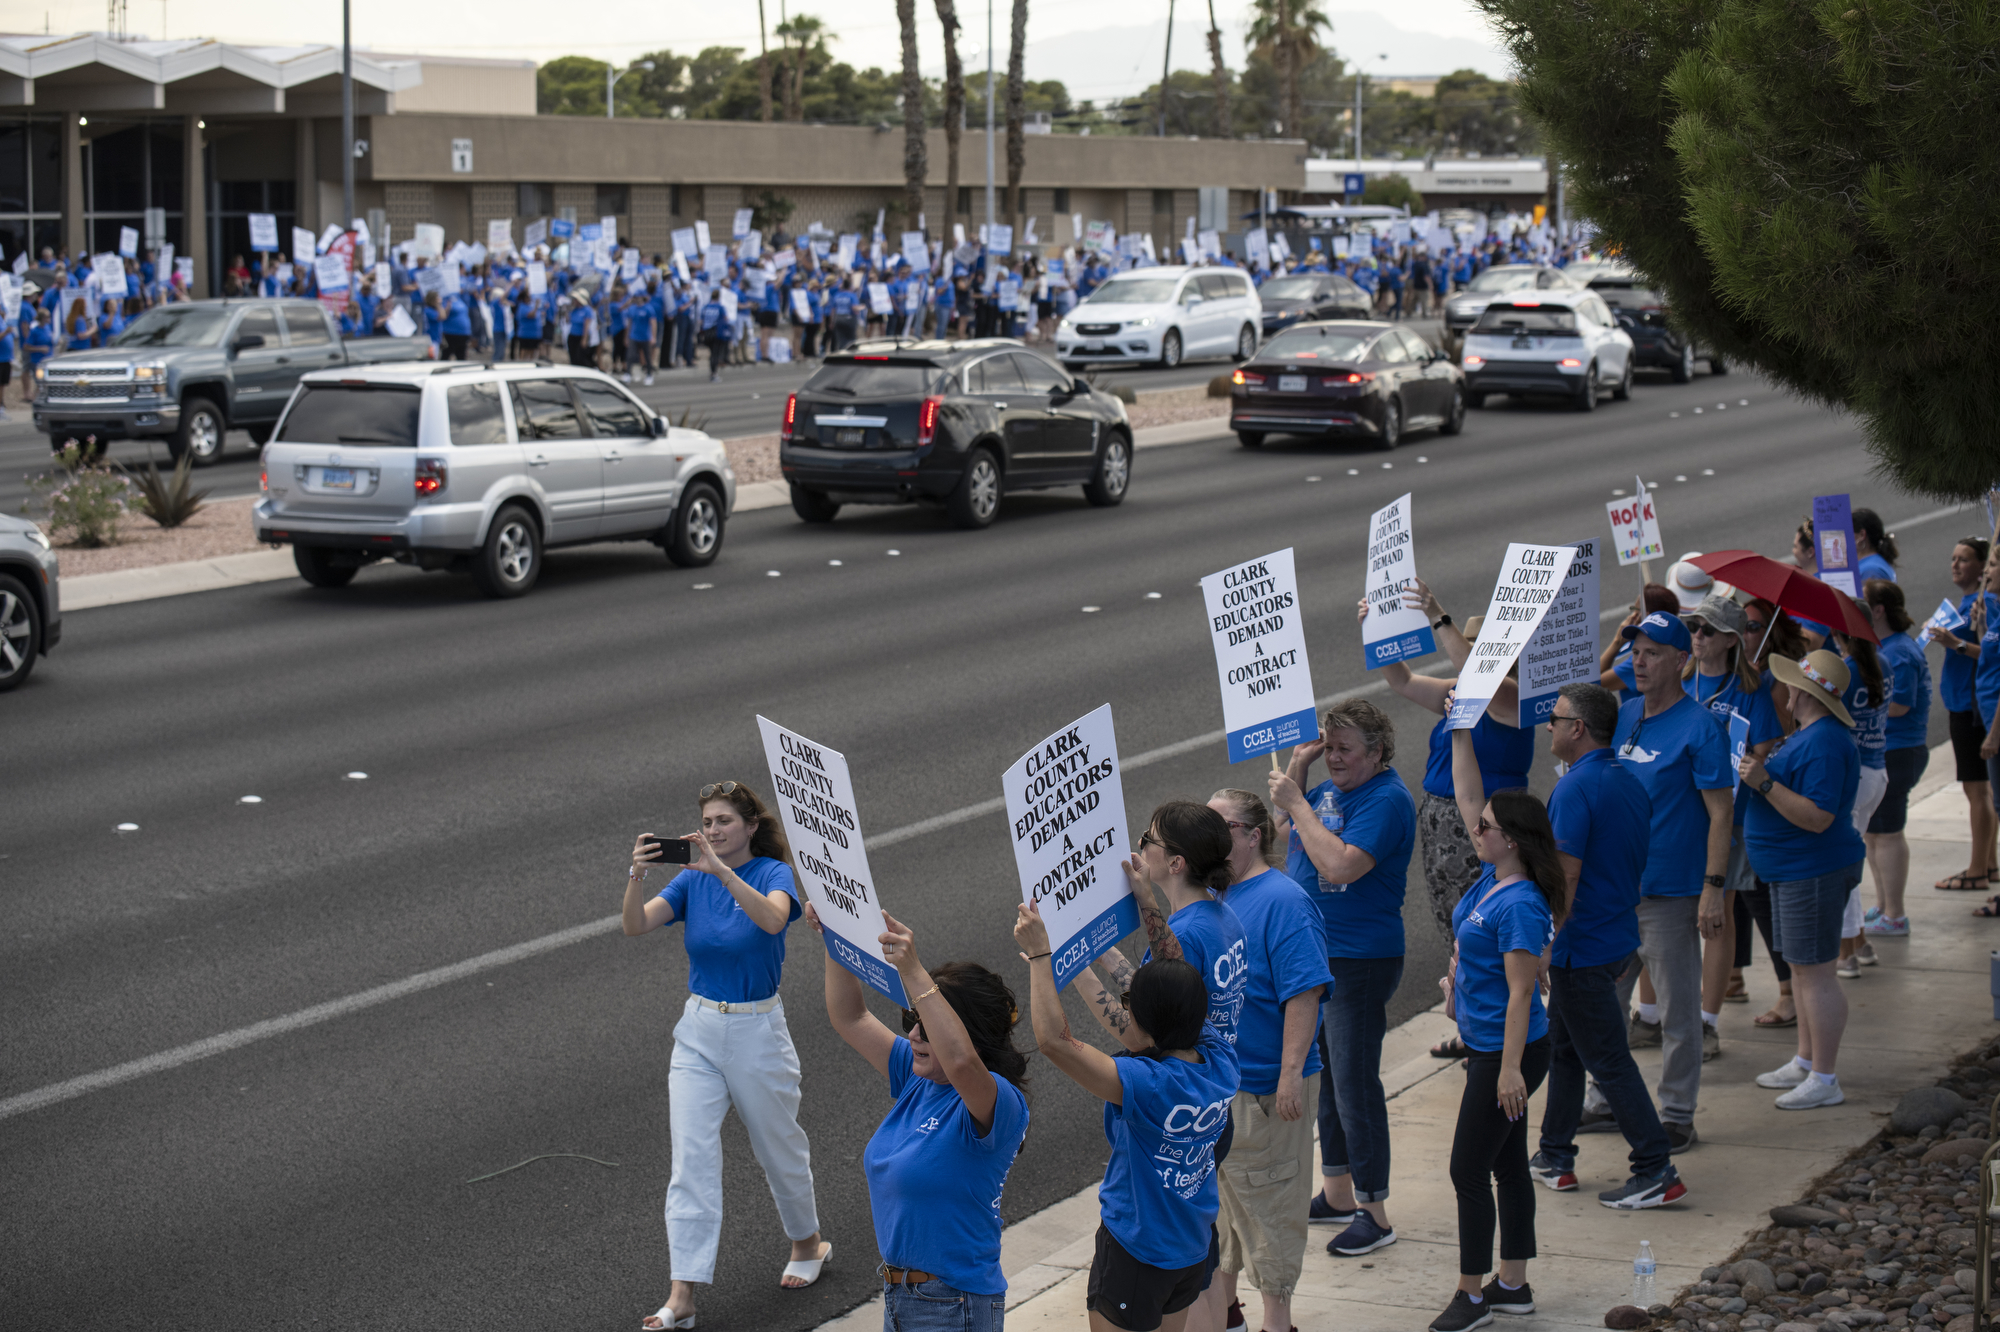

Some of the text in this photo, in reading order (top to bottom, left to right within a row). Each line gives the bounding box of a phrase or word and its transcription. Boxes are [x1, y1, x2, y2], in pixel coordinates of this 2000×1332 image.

[1379, 502, 1400, 525] CLARK
[1375, 517, 1402, 542] COUNTY
[1369, 529, 1409, 561] EDUCATORS
[1573, 543, 1594, 559] OR
[1372, 548, 1404, 573] DEMAND
[1521, 549, 1558, 567] CLARK
[1223, 560, 1270, 589] CLARK
[1384, 569, 1390, 583] A
[1511, 568, 1554, 586] COUNTY
[1222, 577, 1276, 609] COUNTY
[1367, 578, 1411, 605] CONTRACT
[1495, 586, 1554, 604] EDUCATORS
[1562, 586, 1579, 597] Year
[1581, 583, 1585, 593] 1
[1213, 591, 1294, 633] EDUCATORS
[1378, 597, 1402, 617] NOW!
[1496, 605, 1537, 622] DEMAND
[1551, 598, 1584, 615] in Year 2
[1227, 614, 1284, 647] DEMAND
[1501, 625, 1512, 639] A
[1542, 620, 1554, 632] 5%
[1555, 618, 1566, 629] for
[1566, 612, 1587, 626] SPED
[1540, 633, 1555, 648] $5K
[1556, 632, 1567, 643] for
[1567, 627, 1584, 640] Title
[1254, 641, 1265, 658] A
[1375, 641, 1402, 659] CCEA
[1475, 642, 1522, 657] CONTRACT
[1527, 640, 1593, 664] Healthcare Equity
[1227, 649, 1297, 686] CONTRACT
[1474, 659, 1501, 674] NOW!
[1542, 664, 1556, 676] Pay
[1557, 660, 1568, 672] for
[1569, 653, 1594, 669] Added
[1247, 673, 1282, 699] NOW!
[1531, 667, 1590, 689] Instruction Time
[1535, 697, 1557, 715] CCE
[1282, 719, 1299, 731] union
[1243, 727, 1276, 749] CCEA
[779, 732, 826, 772] CLARK
[1025, 726, 1083, 778] CLARK
[781, 756, 835, 799] COUNTY
[1024, 744, 1091, 806] COUNTY
[774, 773, 855, 831] EDUCATORS
[1014, 757, 1114, 842] EDUCATORS
[791, 803, 849, 850] DEMAND
[1030, 789, 1101, 854] DEMAND
[823, 842, 834, 863] A
[1062, 833, 1075, 855] A
[1031, 826, 1116, 904] CONTRACT
[798, 850, 869, 904] CONTRACT
[1054, 865, 1097, 912] NOW!
[822, 883, 860, 920] NOW!
[1092, 923, 1118, 946] of teaching
[1096, 913, 1117, 934] union
[1093, 930, 1119, 954] professionals
[834, 938, 866, 973] CCEA
[1055, 936, 1090, 977] CCEA
[1210, 1009, 1230, 1022] the
[1159, 1142, 1183, 1159] the
